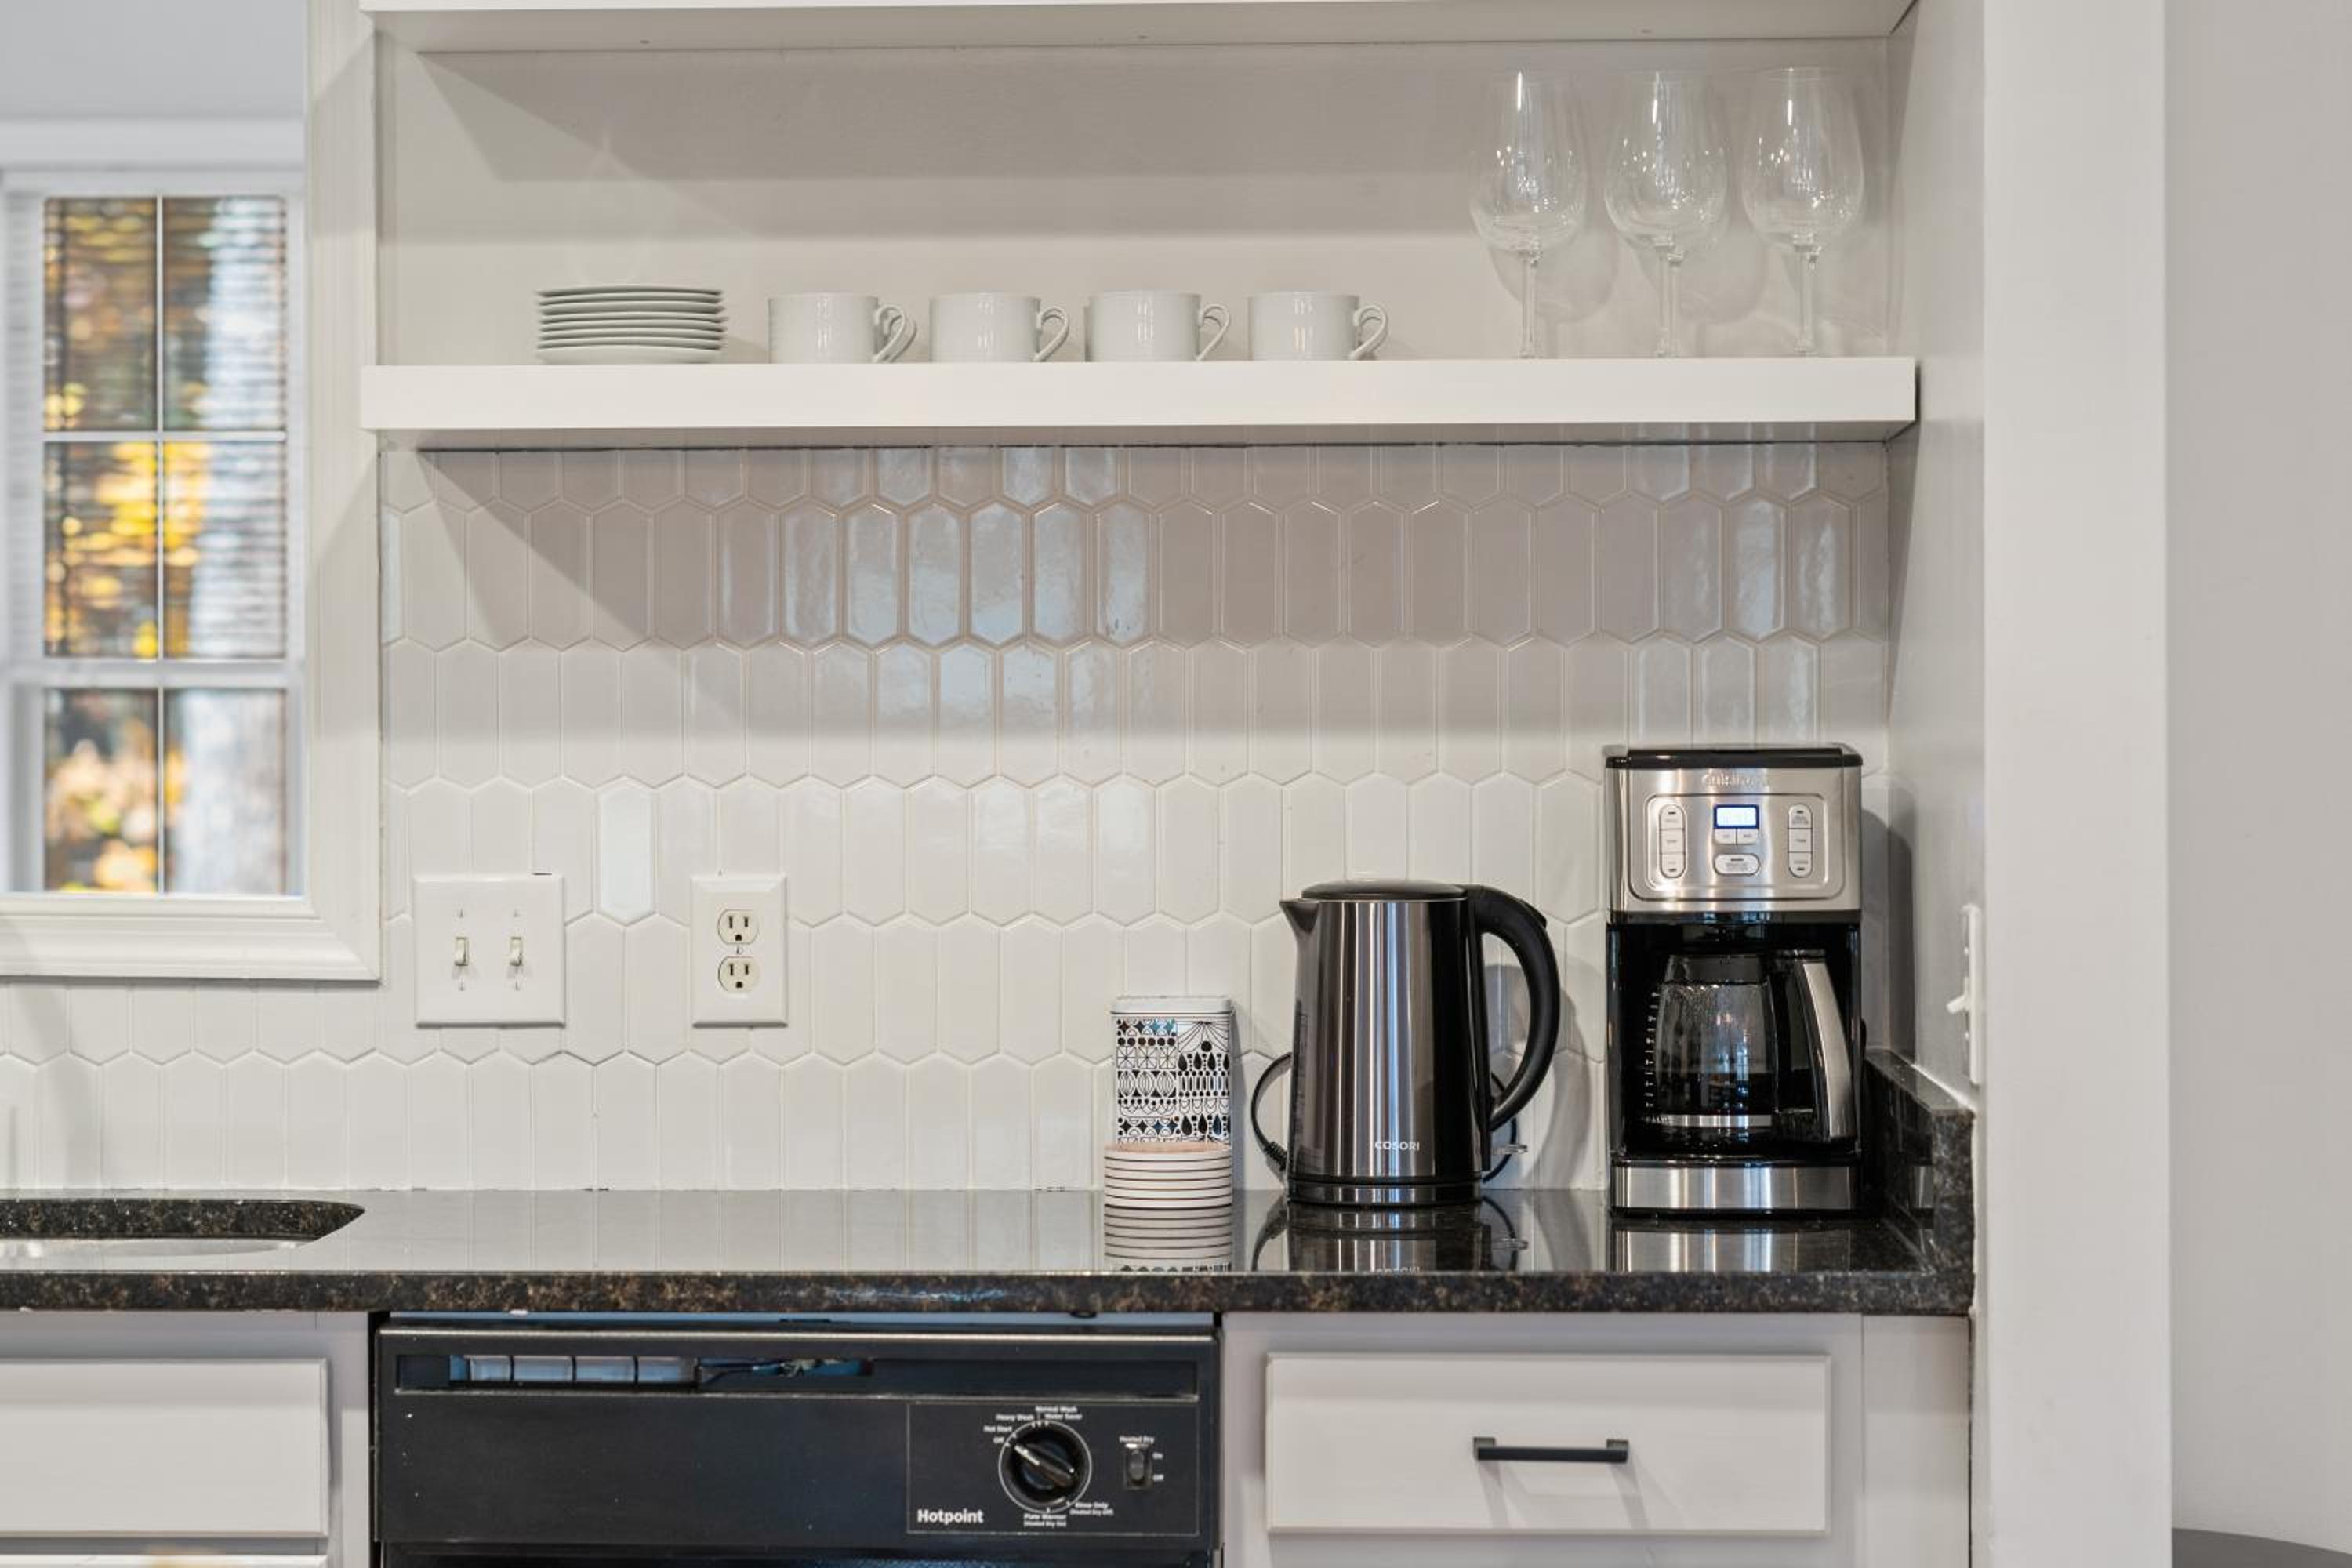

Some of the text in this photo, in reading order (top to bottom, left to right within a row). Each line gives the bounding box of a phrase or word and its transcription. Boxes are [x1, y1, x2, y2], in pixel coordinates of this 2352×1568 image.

[1374, 1141, 1420, 1151] COSORI
[1142, 1436, 1154, 1444] Dry
[916, 1508, 985, 1526] Hotpoint
